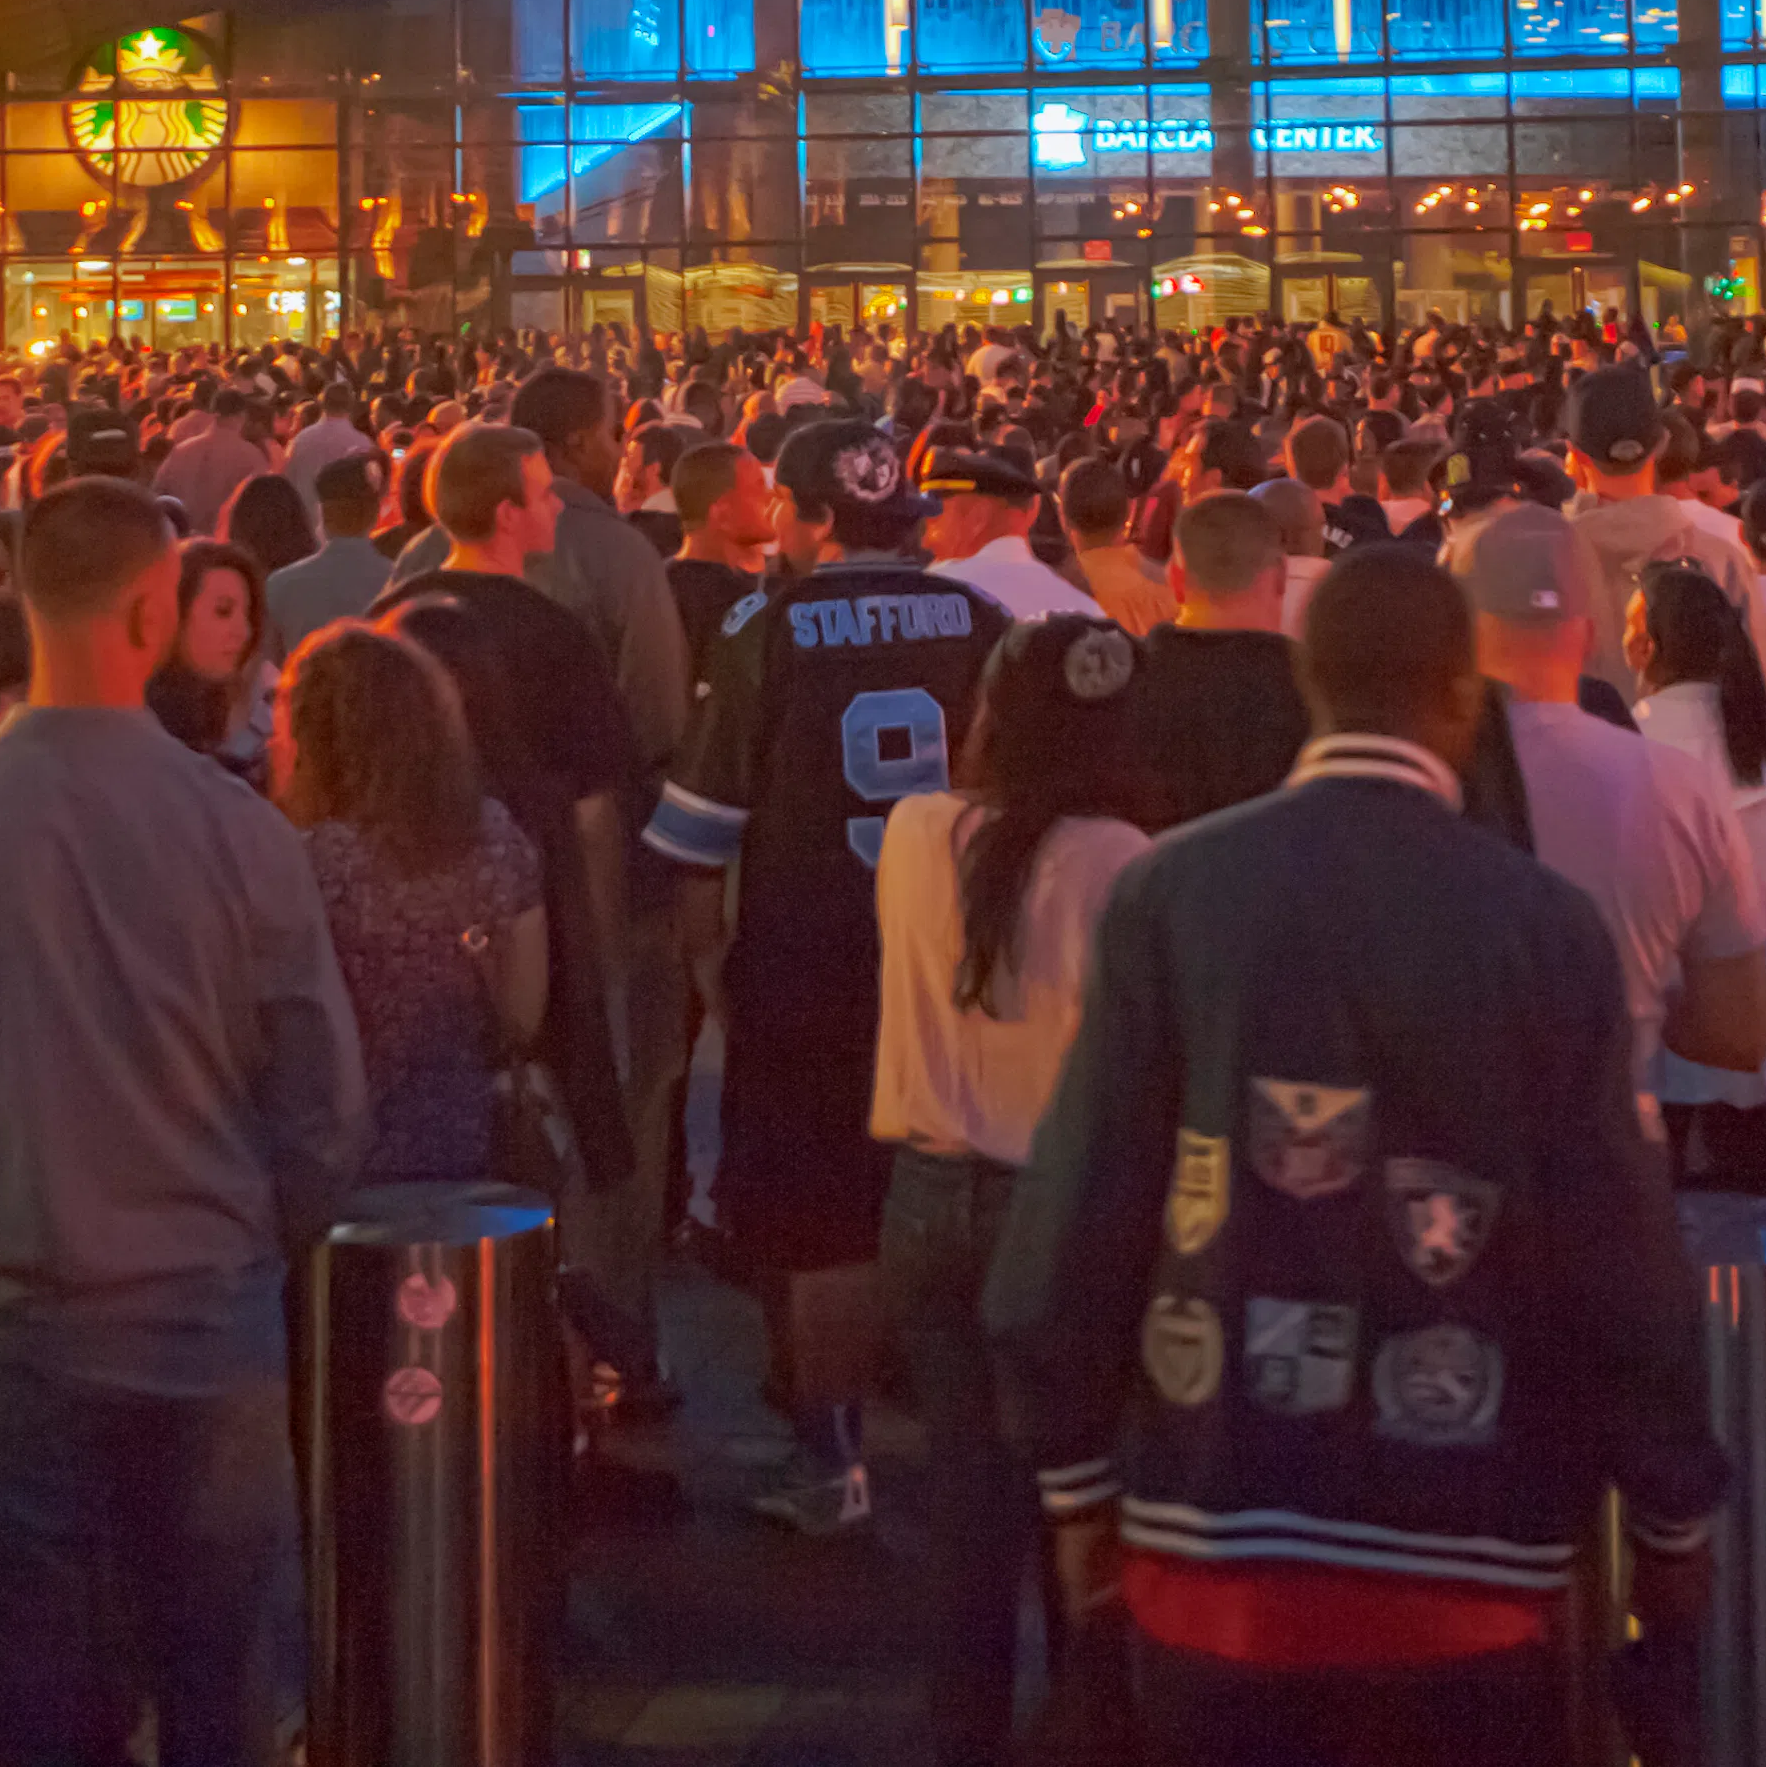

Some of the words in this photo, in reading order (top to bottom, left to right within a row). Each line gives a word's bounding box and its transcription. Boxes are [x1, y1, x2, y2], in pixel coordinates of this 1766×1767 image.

[1092, 118, 1215, 153] BARCLA
[1249, 118, 1384, 152] CENTER
[789, 593, 973, 648] STAFFORD
[841, 686, 950, 870] 9
